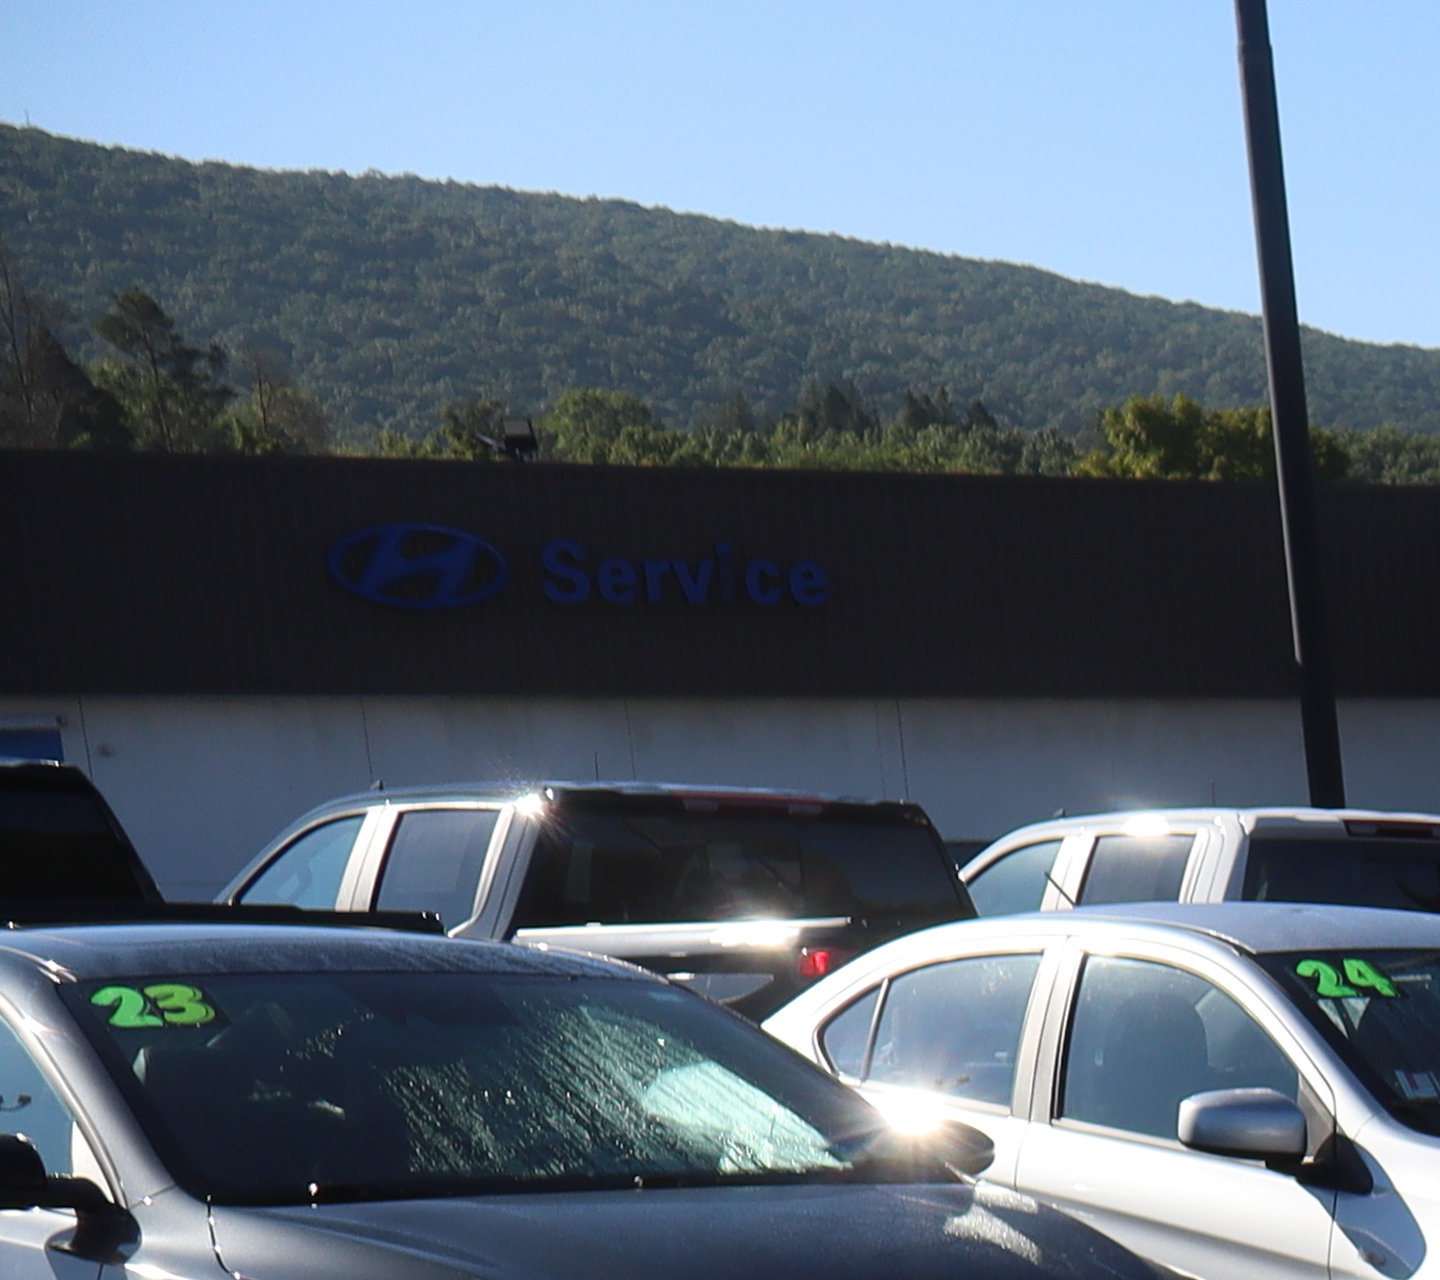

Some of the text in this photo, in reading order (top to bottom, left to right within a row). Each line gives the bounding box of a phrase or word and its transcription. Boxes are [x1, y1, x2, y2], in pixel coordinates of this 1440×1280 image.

[540, 538, 830, 606] Service
[1296, 958, 1398, 998] 24
[90, 983, 216, 1028] 23
